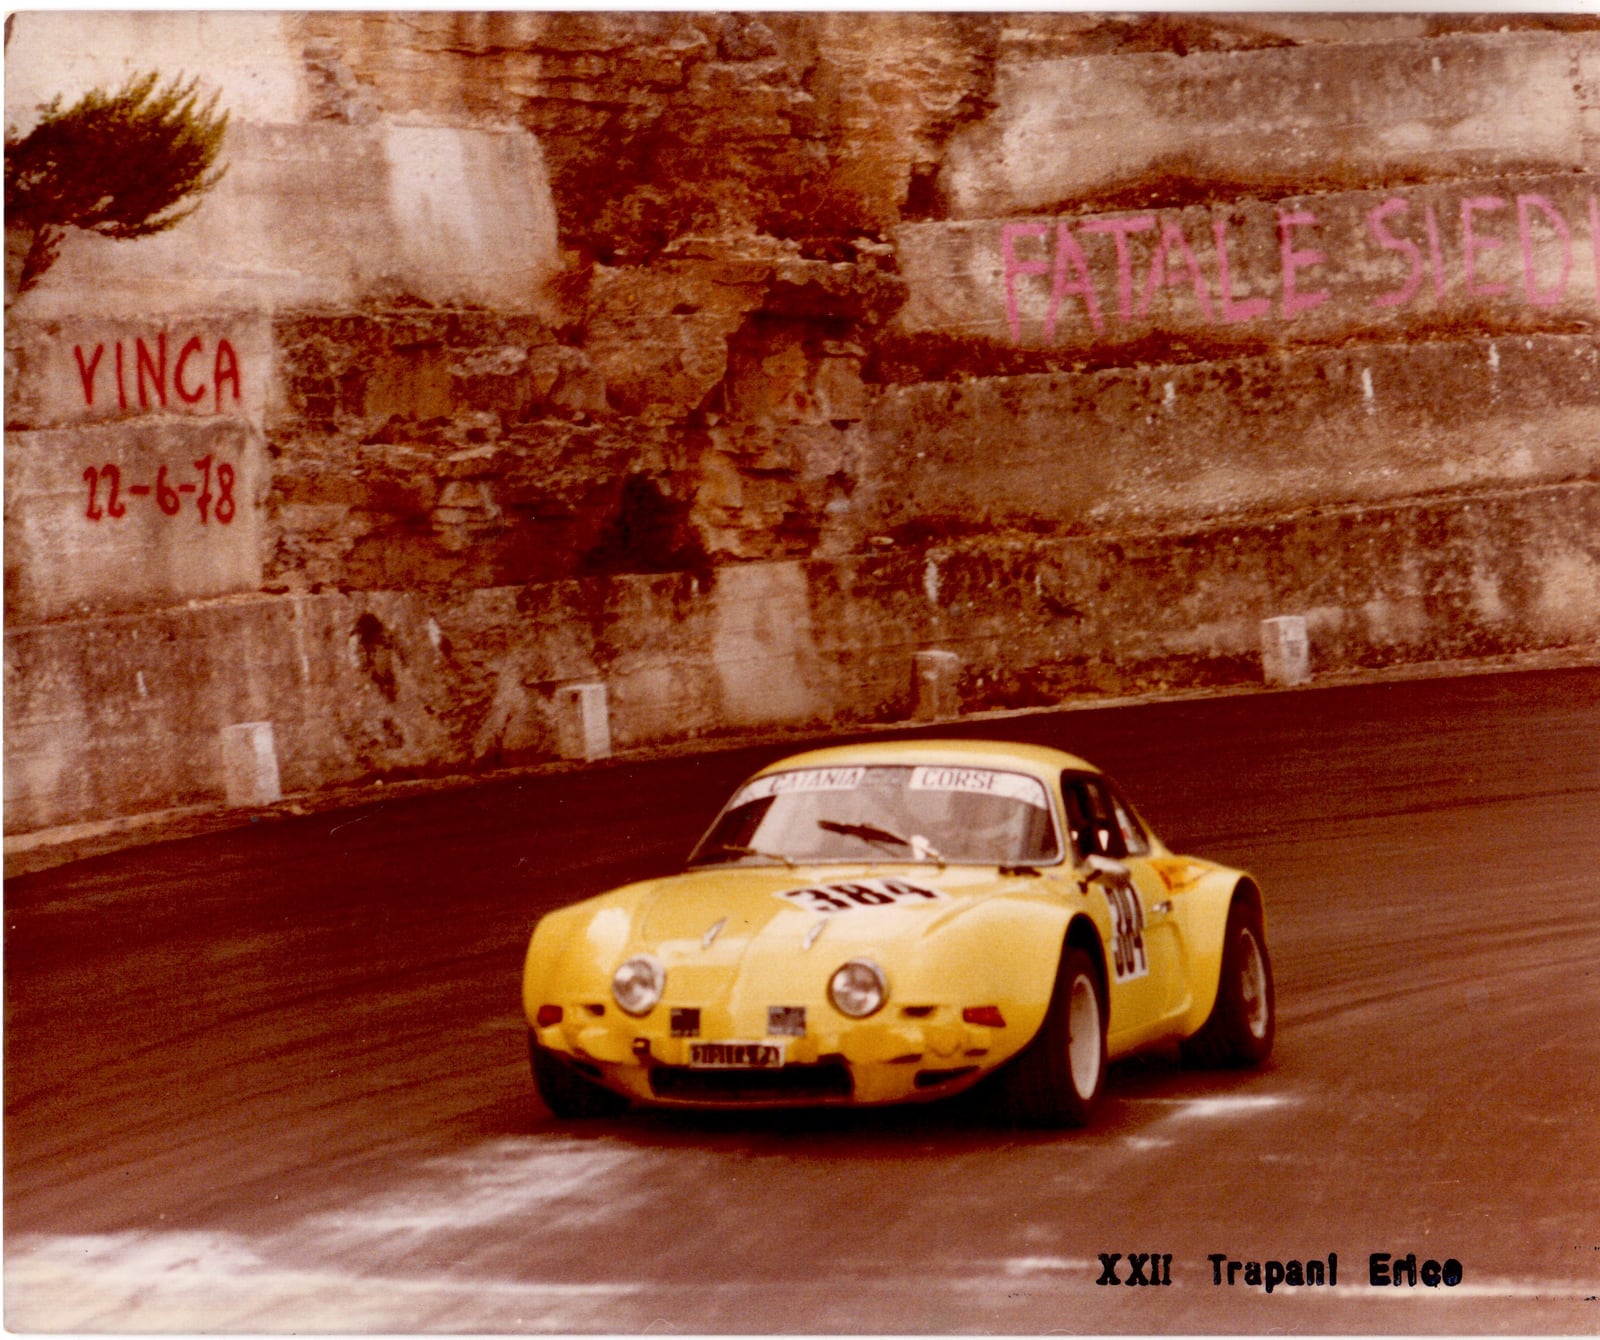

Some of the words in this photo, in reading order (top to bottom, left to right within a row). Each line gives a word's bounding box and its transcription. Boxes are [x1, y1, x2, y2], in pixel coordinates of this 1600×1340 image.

[1000, 207, 1331, 343] FATALE
[74, 332, 240, 413] VINCA
[83, 454, 236, 525] 22-6-78
[784, 879, 938, 912] 384
